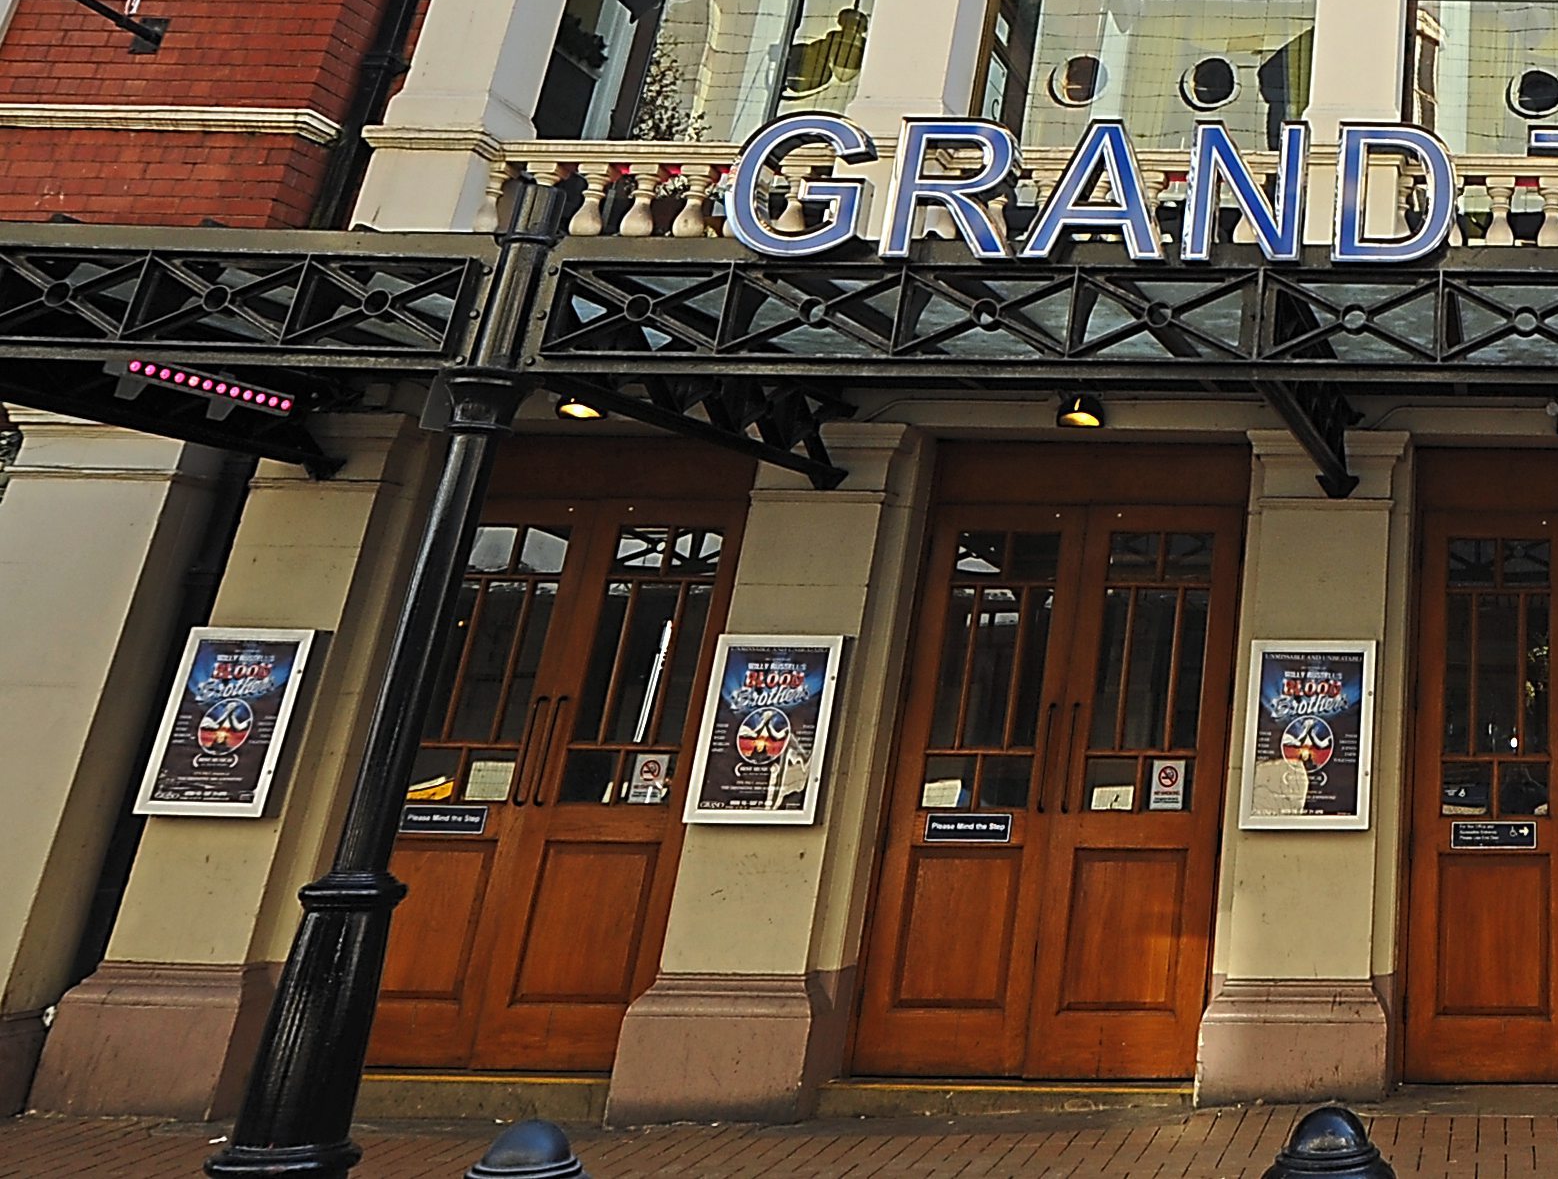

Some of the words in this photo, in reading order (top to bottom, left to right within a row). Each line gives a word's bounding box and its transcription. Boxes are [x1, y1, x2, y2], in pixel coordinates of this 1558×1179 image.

[725, 111, 1458, 263] GRAND
[212, 662, 273, 680] BLOOD
[743, 671, 805, 688] BLOOD
[196, 677, 275, 702] Brothers
[1281, 679, 1343, 697] BLOOD
[730, 686, 810, 711] Brothers
[1271, 694, 1349, 719] Brothers
[407, 813, 431, 822] Please
[432, 814, 450, 822] Mind
[451, 814, 463, 822] the
[464, 814, 481, 823] Step
[931, 822, 955, 831] Please
[956, 822, 974, 831] Mind
[975, 822, 988, 831] the
[988, 822, 1006, 832] Step
